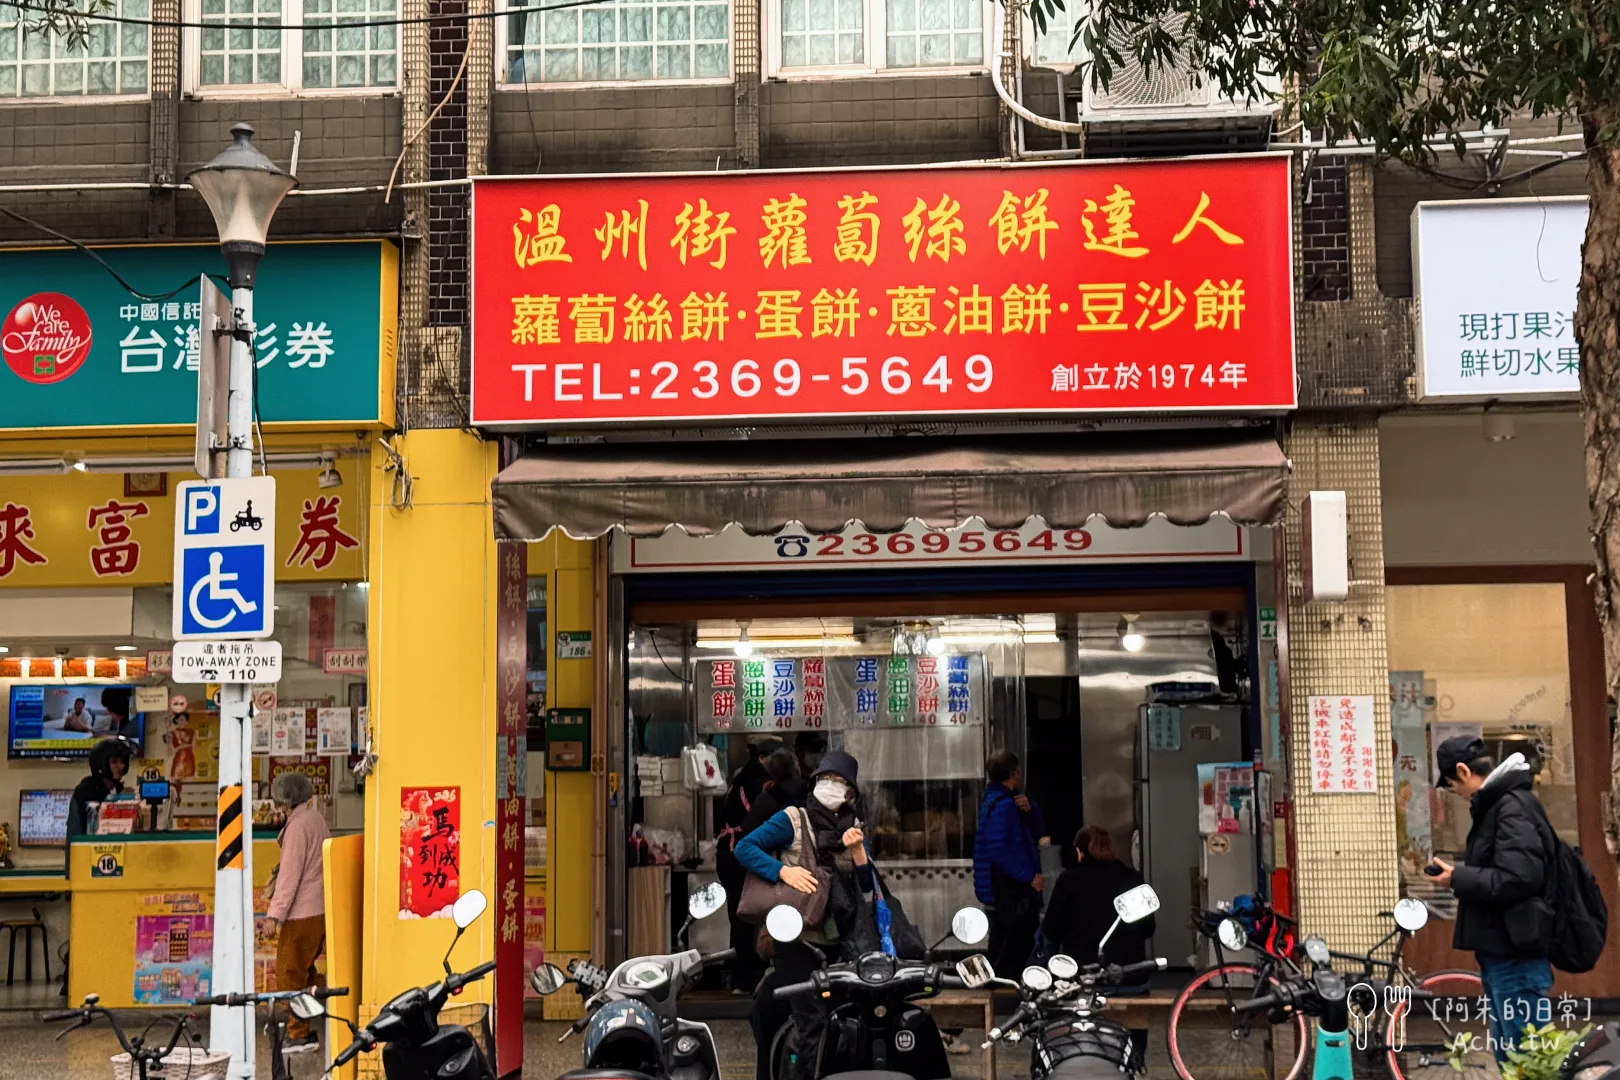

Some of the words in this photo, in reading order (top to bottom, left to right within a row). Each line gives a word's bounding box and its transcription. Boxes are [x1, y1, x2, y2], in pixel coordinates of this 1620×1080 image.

[513, 184, 1244, 272] 溫州街蘿蔔絲餅達人
[31, 304, 61, 323] We
[43, 321, 70, 335] are
[2, 324, 92, 364] Family
[511, 354, 994, 403] TEL:2369-5649
[1050, 360, 1248, 392] 創立於1974年
[187, 491, 217, 531] P
[816, 529, 1094, 556] 23695649
[180, 656, 241, 667] TOW-AWAY
[245, 656, 277, 667] ZONE
[203, 643, 254, 655] 違者拖吊
[228, 669, 256, 680] 110
[712, 660, 736, 718] 蛋餅
[772, 659, 796, 717] 豆沙餅
[802, 658, 825, 716] 蘿蔔絲餅
[855, 657, 879, 713] 蛋餅
[917, 656, 940, 713] 豆沙餅
[946, 655, 970, 713] 蘿蔔絲餅
[775, 716, 792, 728] 40
[804, 716, 822, 728] 40
[919, 713, 937, 725] 40
[949, 712, 967, 725] 40
